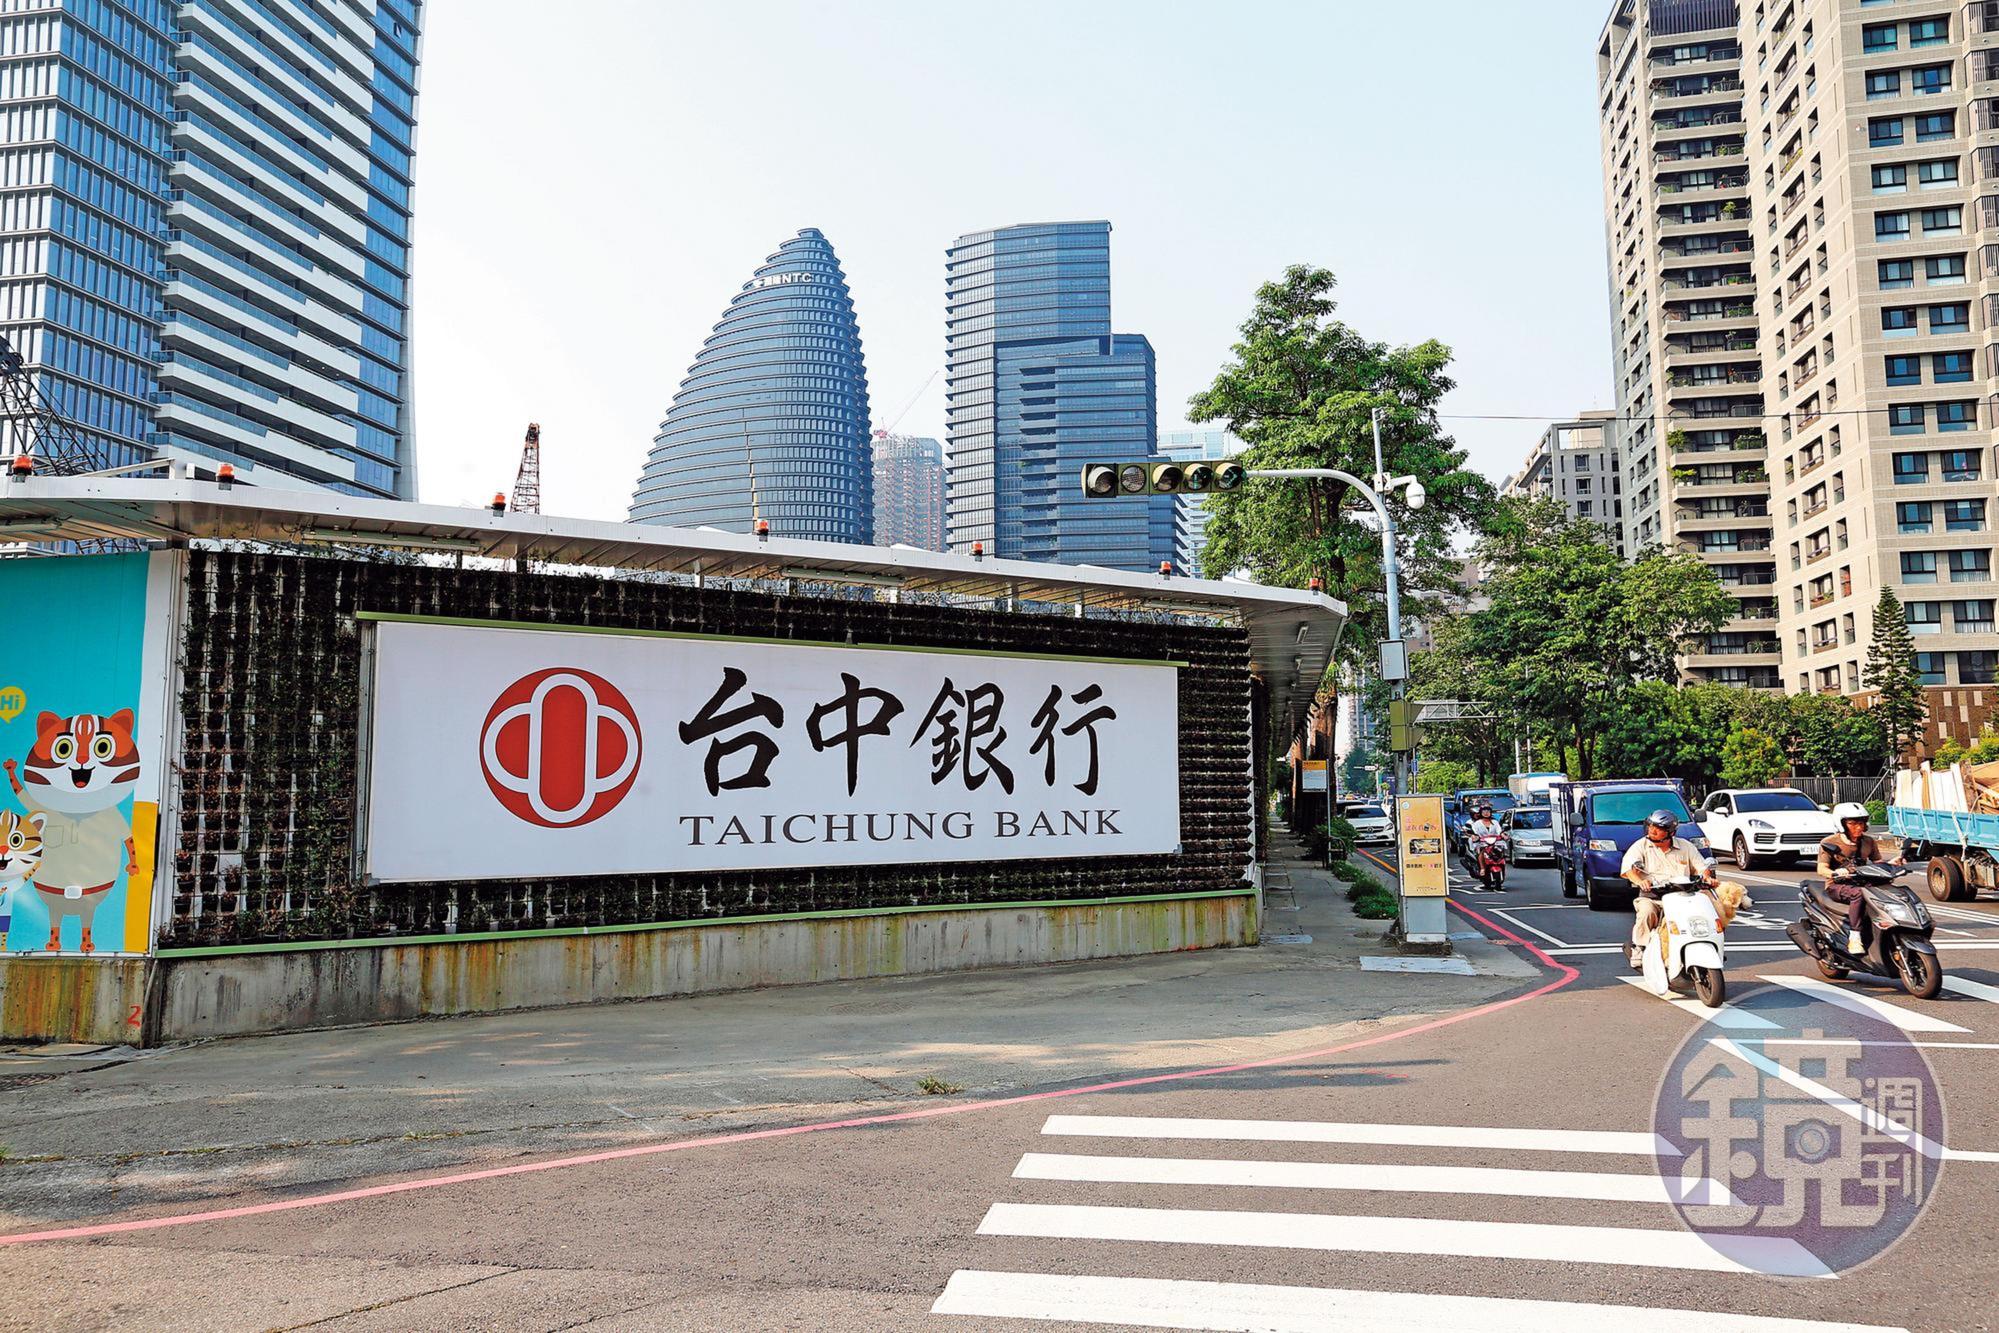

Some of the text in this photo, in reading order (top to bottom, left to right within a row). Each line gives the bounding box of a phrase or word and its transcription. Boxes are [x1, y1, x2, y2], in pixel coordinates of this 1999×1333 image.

[782, 272, 812, 283] NTC
[1, 695, 19, 710] Hi
[679, 667, 1117, 797] 台中銀行
[679, 809, 1123, 846] TAICHUNG BANK
[128, 1005, 141, 1027] 2
